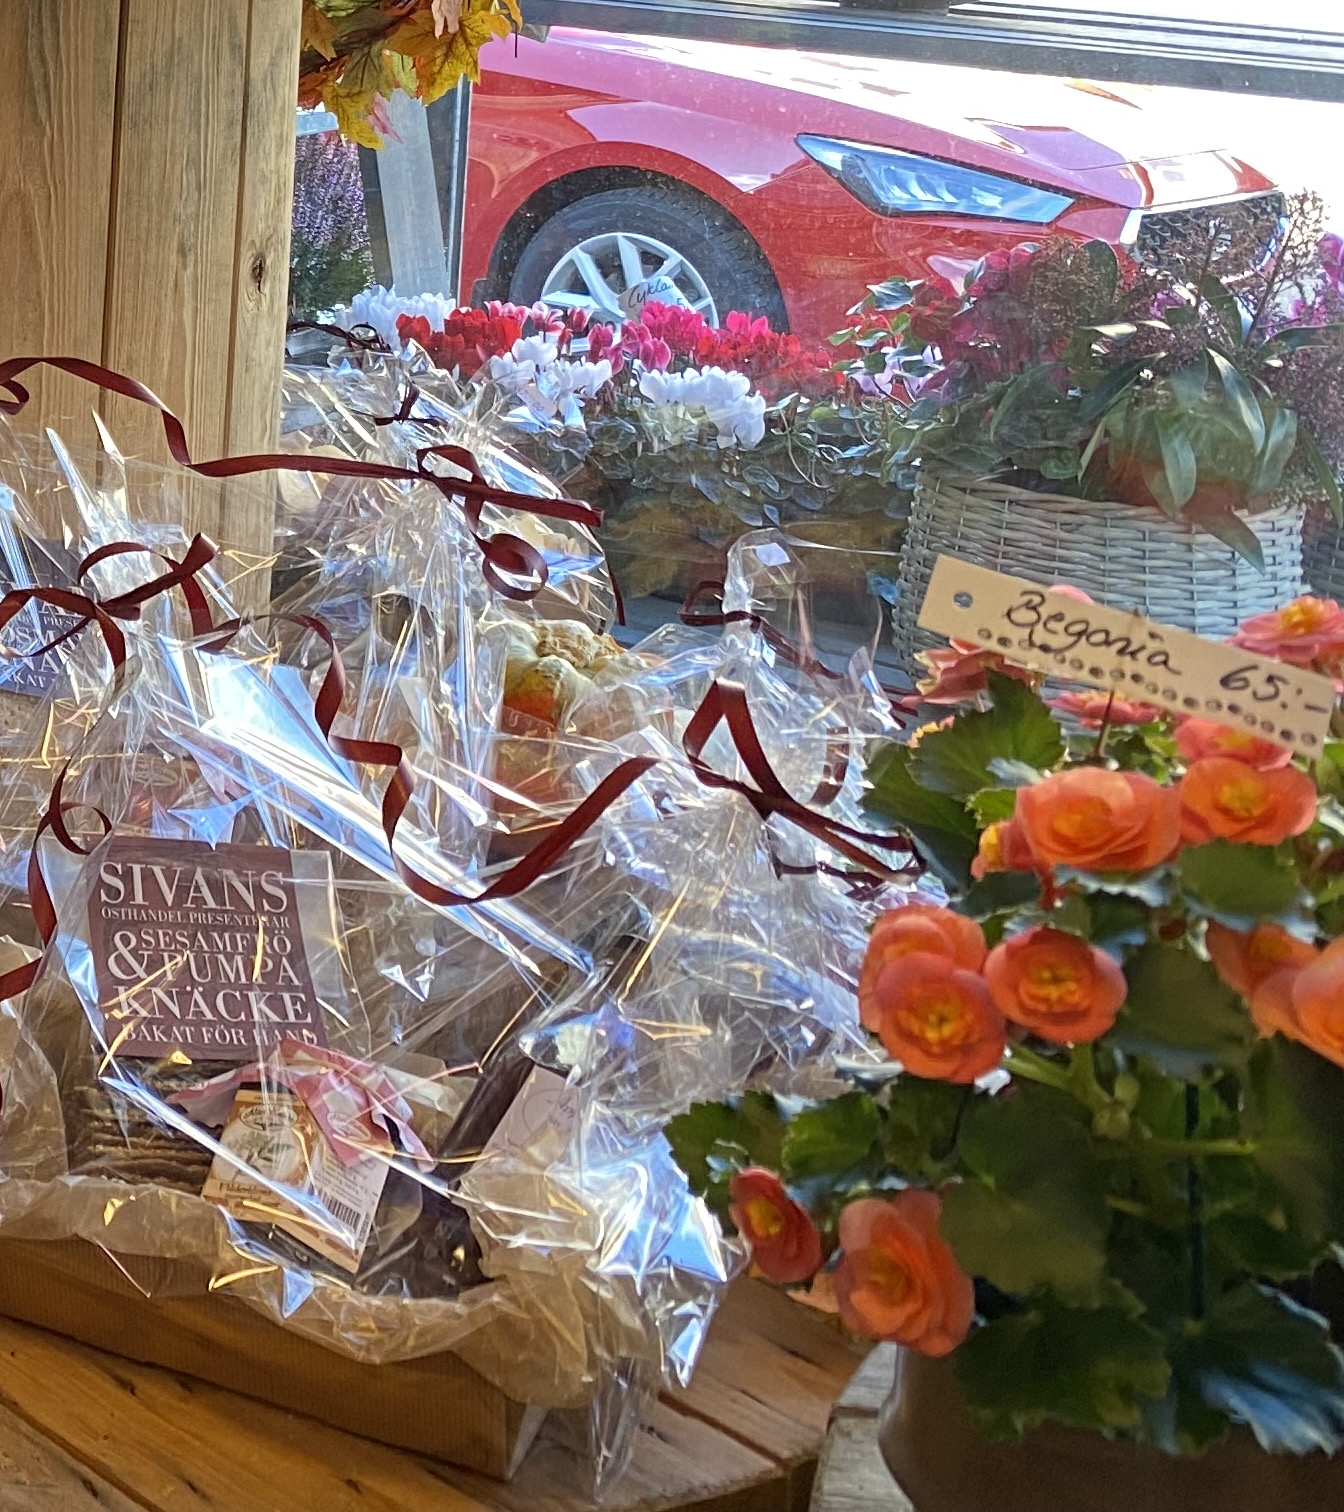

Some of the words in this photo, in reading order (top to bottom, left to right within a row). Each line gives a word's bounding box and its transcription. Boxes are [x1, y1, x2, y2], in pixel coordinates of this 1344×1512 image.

[1004, 590, 1182, 675] Begonia
[1219, 663, 1328, 713] 65:-
[99, 862, 289, 913] SIVANS
[107, 930, 149, 980] &
[113, 985, 312, 1024] KNÄCKE
[202, 1025, 248, 1045] FÖR
